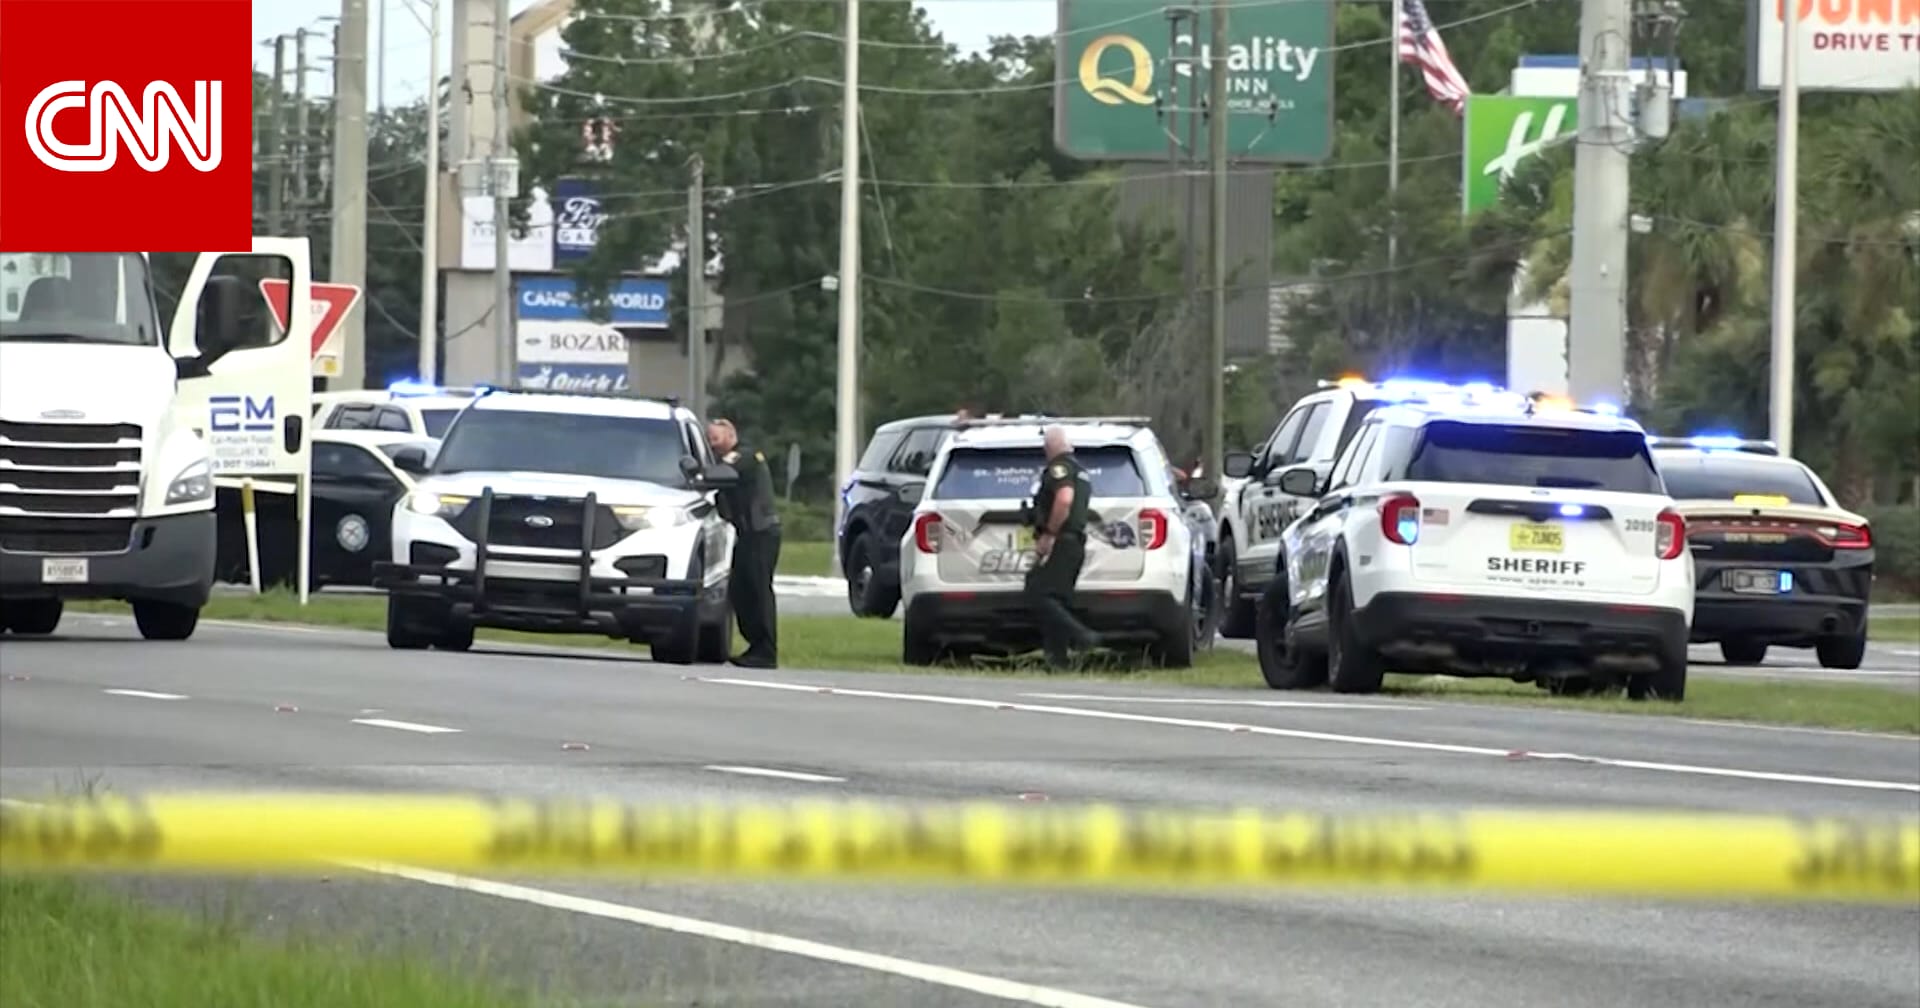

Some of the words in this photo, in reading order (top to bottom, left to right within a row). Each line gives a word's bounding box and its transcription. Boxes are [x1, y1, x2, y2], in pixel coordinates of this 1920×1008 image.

[1813, 32, 1889, 51] DRIVE
[1225, 78, 1269, 96] INN
[558, 196, 608, 231] For
[551, 371, 609, 391] Quick
[1487, 556, 1587, 576] SHERIFF
